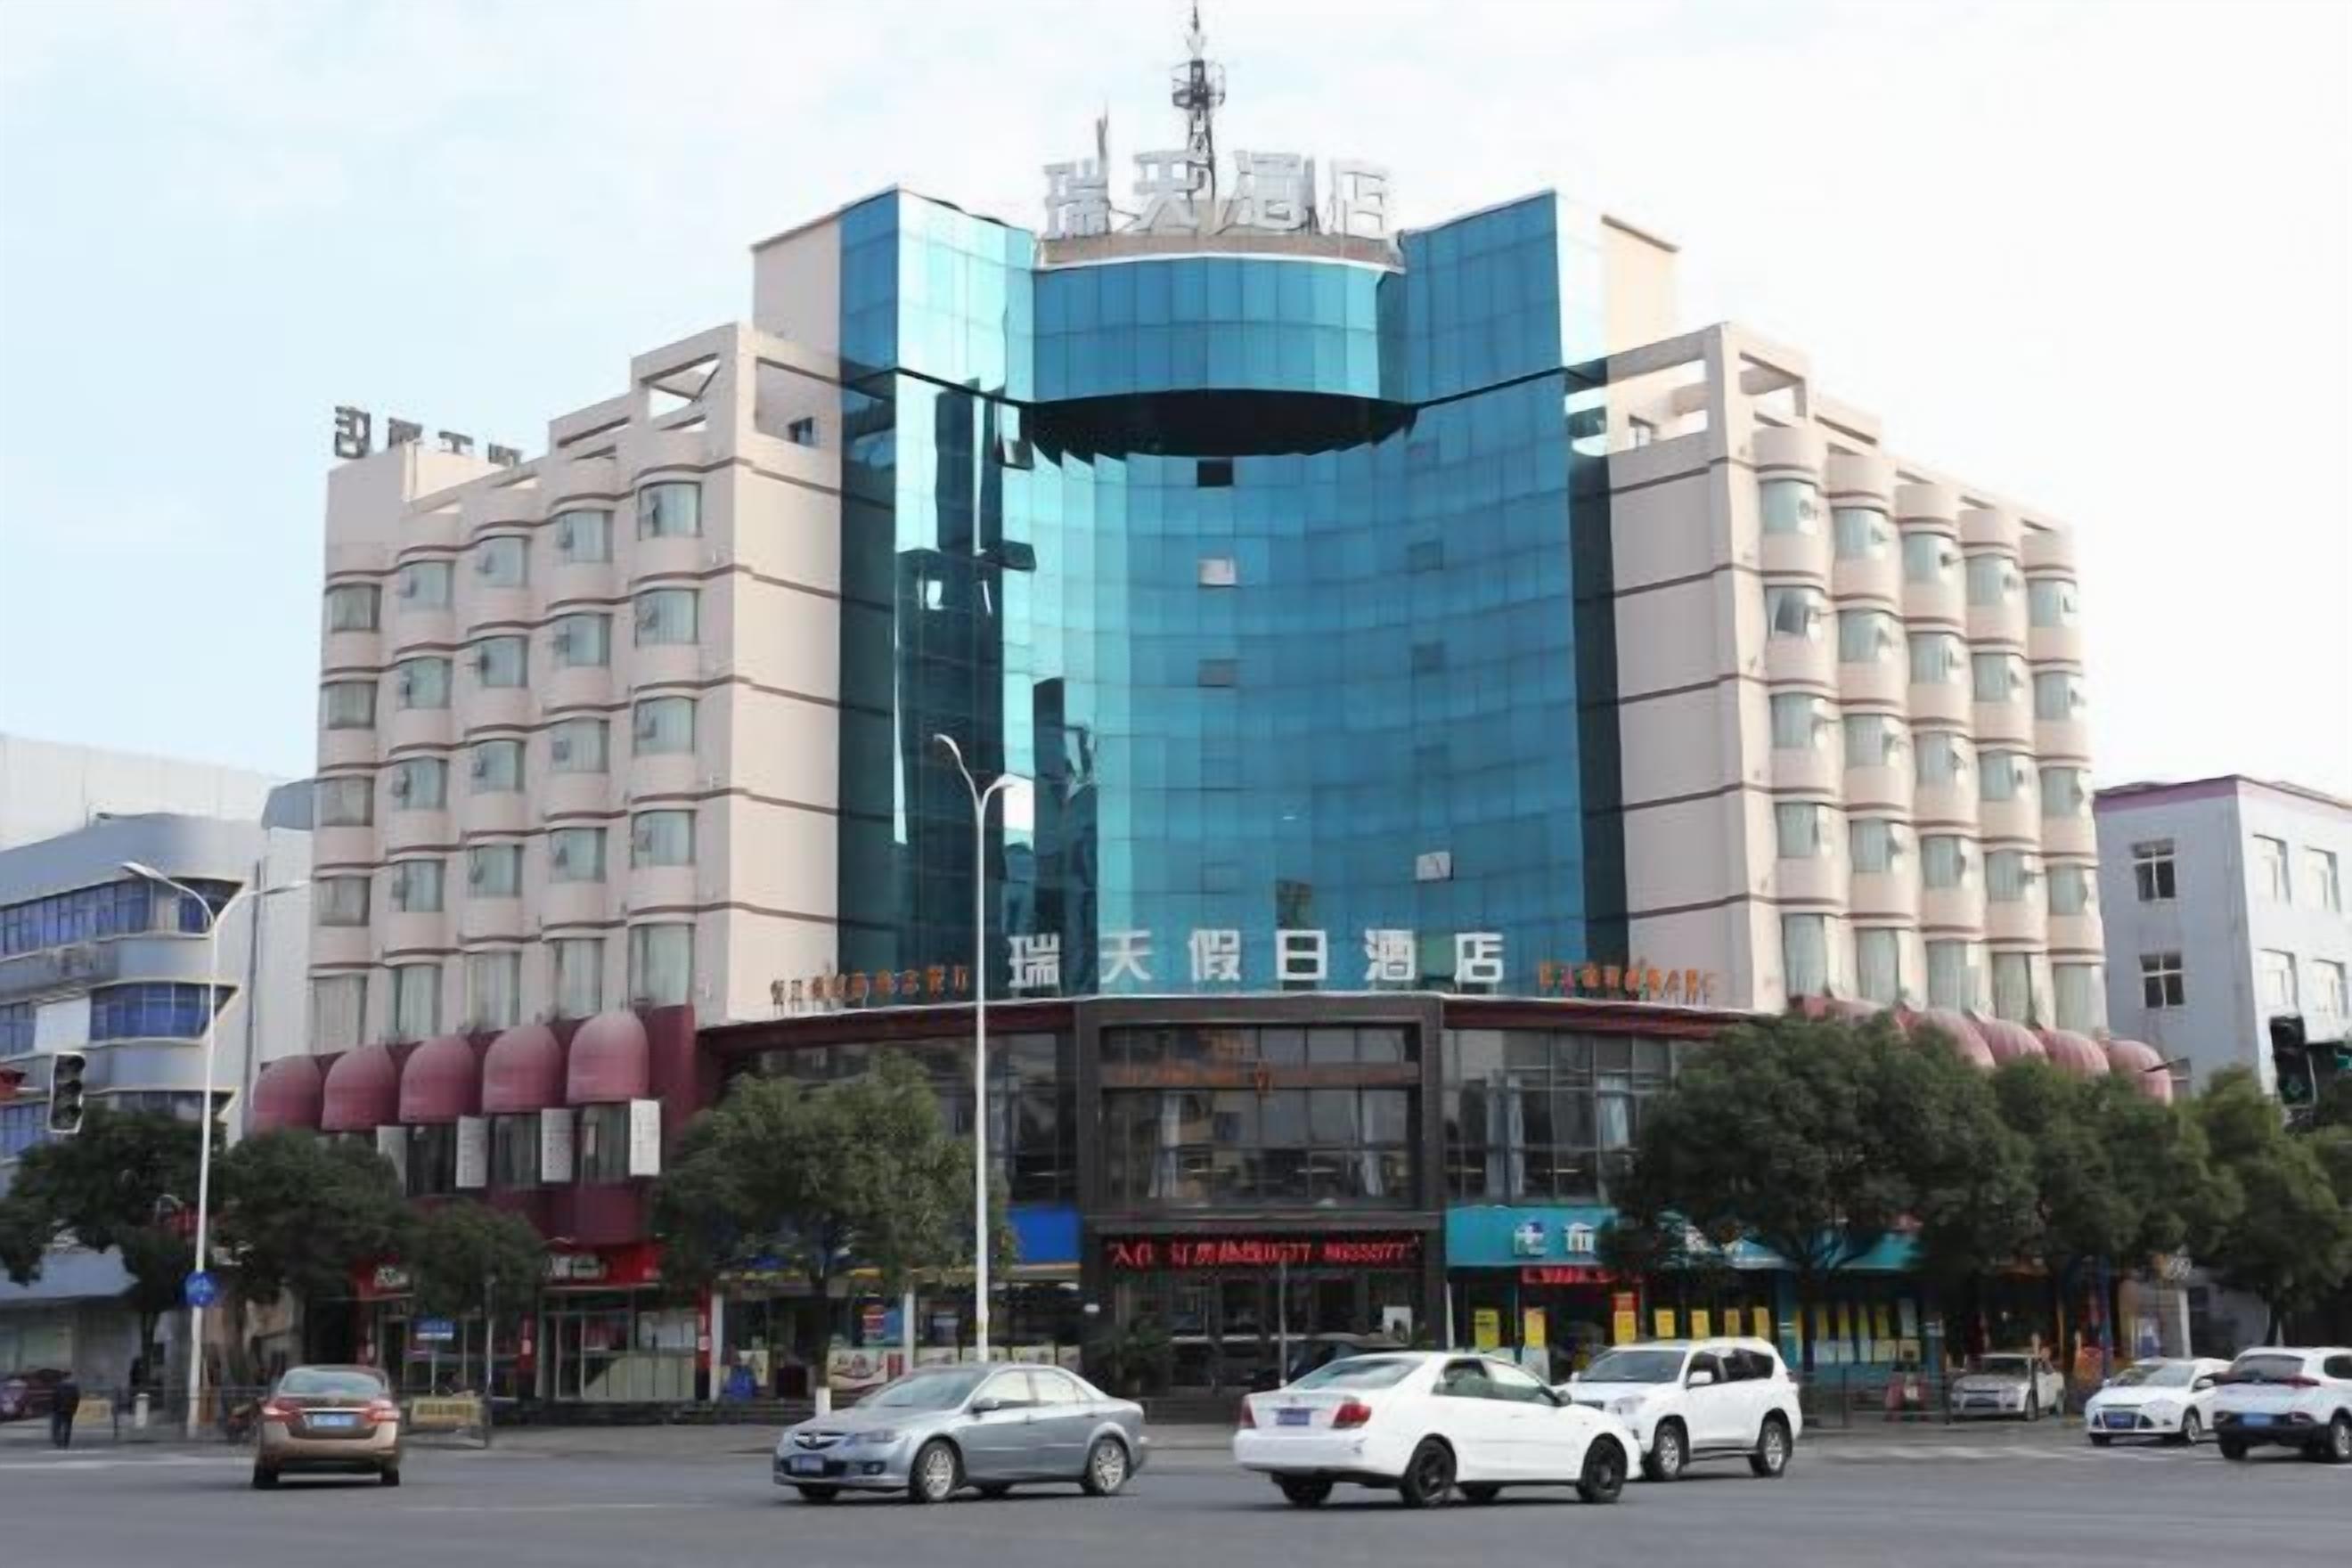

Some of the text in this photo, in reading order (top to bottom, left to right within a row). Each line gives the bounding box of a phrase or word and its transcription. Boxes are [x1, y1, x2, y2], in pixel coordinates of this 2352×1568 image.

[1043, 150, 1390, 235] 瑞天酒店
[1008, 928, 1504, 988] 瑞天假日酒店
